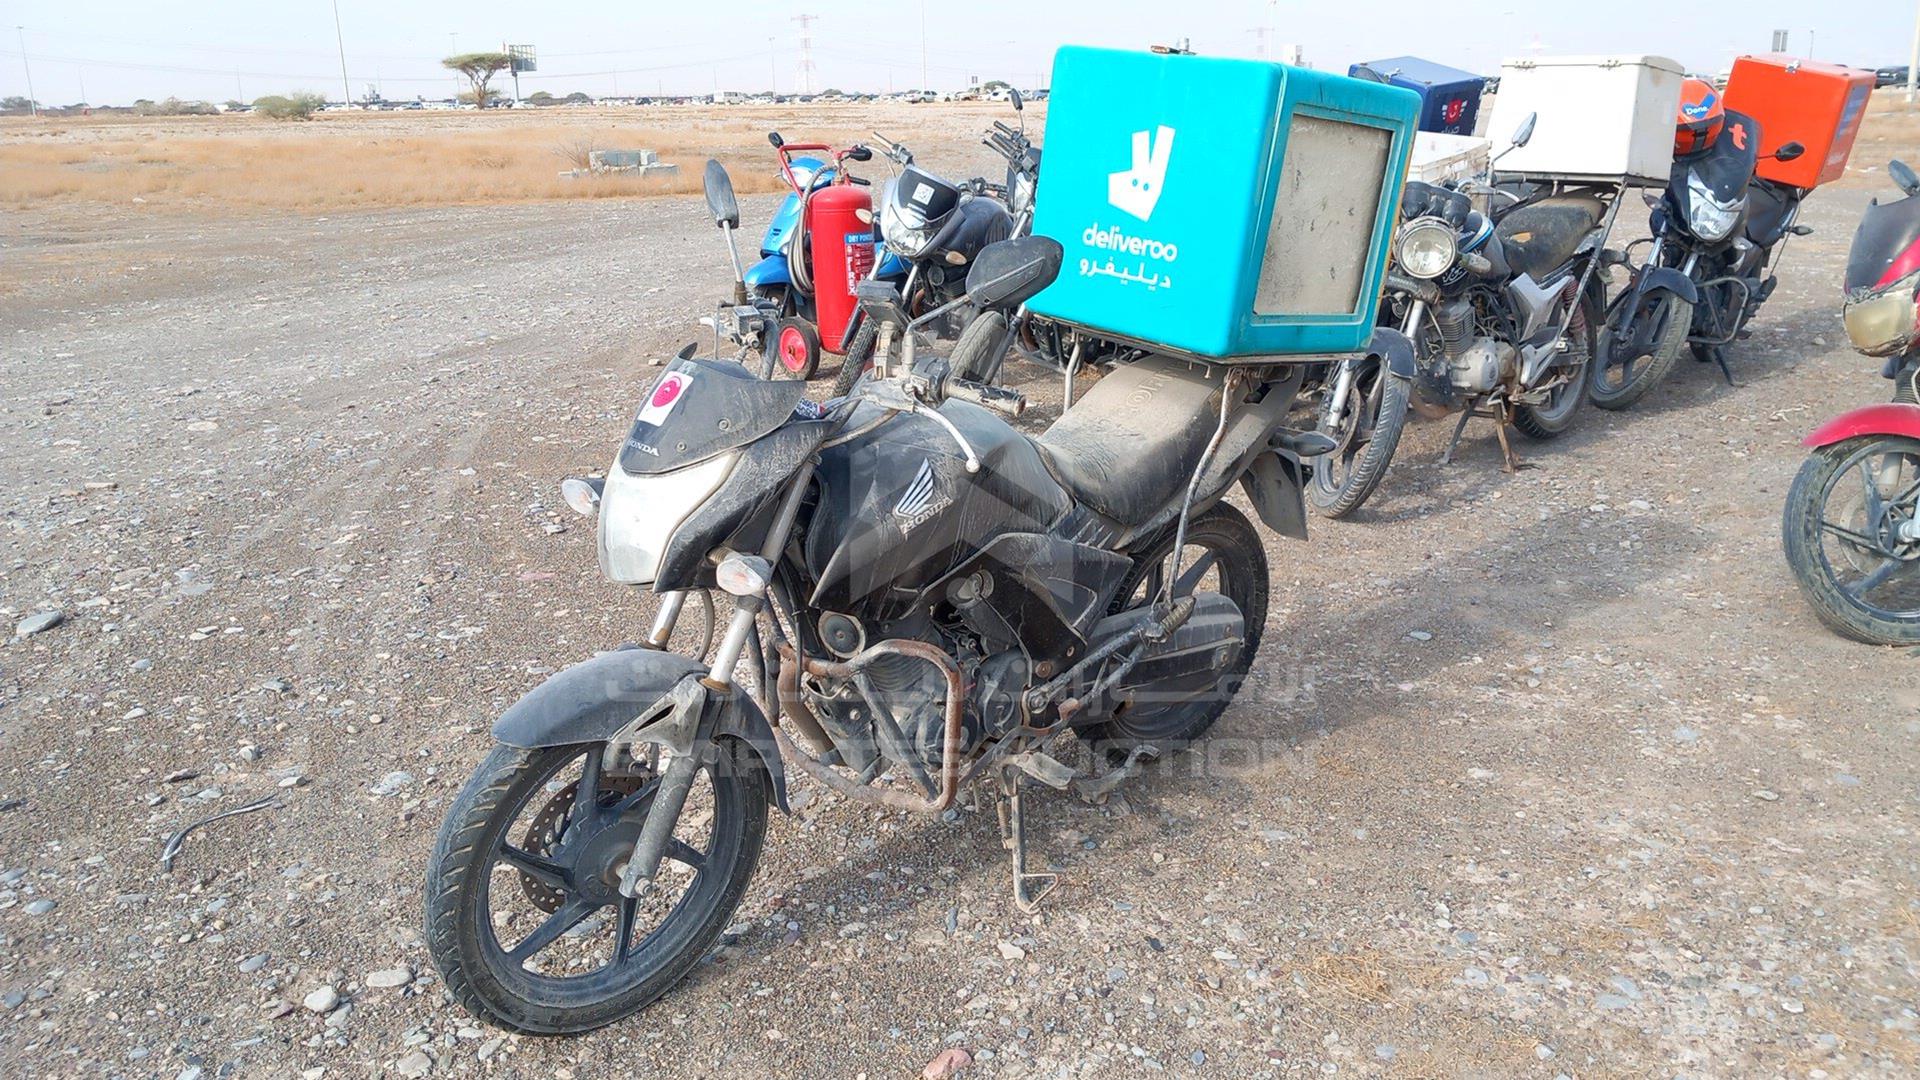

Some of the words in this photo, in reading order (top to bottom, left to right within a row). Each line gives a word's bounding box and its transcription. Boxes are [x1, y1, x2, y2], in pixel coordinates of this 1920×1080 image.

[1728, 123, 1748, 151] t
[1082, 221, 1179, 263] deliveroo
[1079, 255, 1172, 291] ديليفرو
[900, 496, 954, 534] HONDA
